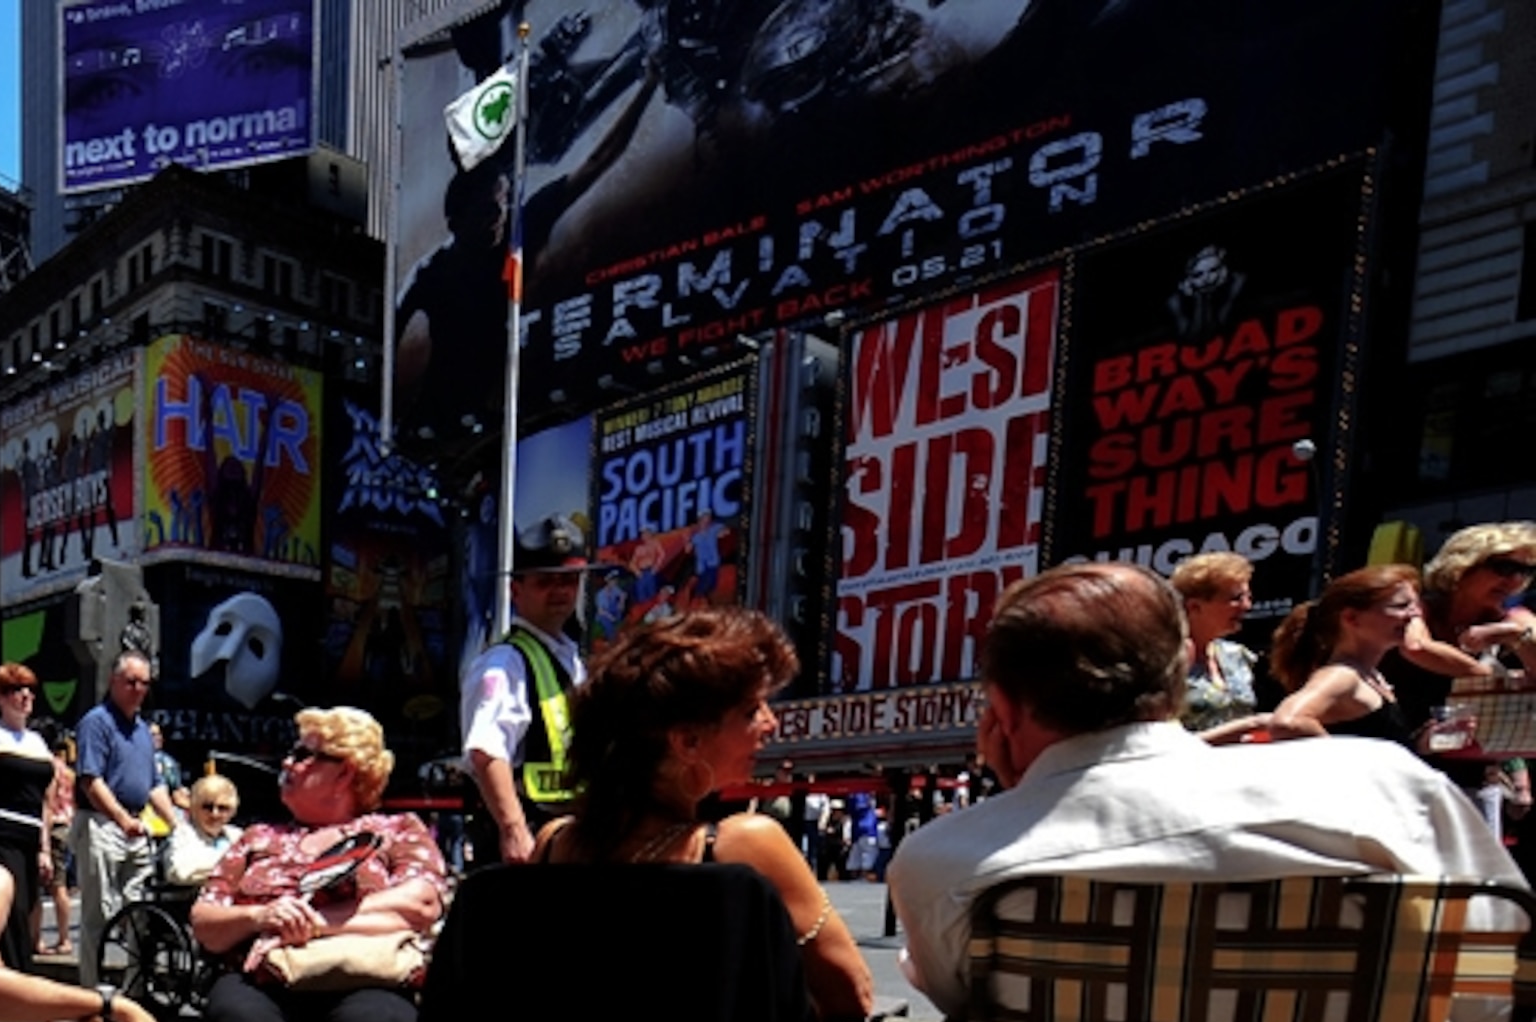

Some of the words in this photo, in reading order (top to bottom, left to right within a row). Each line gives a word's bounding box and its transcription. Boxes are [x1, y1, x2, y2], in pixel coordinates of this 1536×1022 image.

[66, 127, 137, 168] next
[144, 124, 179, 153] to
[508, 97, 1209, 350] TERMINATOR
[584, 237, 701, 288] CHRISTIAN
[702, 212, 768, 248] BALE
[795, 185, 853, 216] SAM
[858, 112, 1073, 197] WORTHINGTON
[891, 237, 1004, 288] 05.21
[619, 336, 670, 365] WE
[677, 307, 764, 349] FIGHT
[775, 275, 874, 320] BACK
[1092, 303, 1325, 394] BROAD
[154, 373, 311, 475] HAIR
[1087, 388, 1317, 479] SURE
[1091, 346, 1321, 432] WAY'S
[600, 419, 746, 501] SOUTH
[840, 411, 1053, 577] SIDE
[1084, 443, 1310, 540] THING
[598, 468, 744, 547] PACIFIC
[833, 566, 1023, 695] STOR
[823, 699, 888, 734] SIDE
[895, 687, 974, 728] STORY
